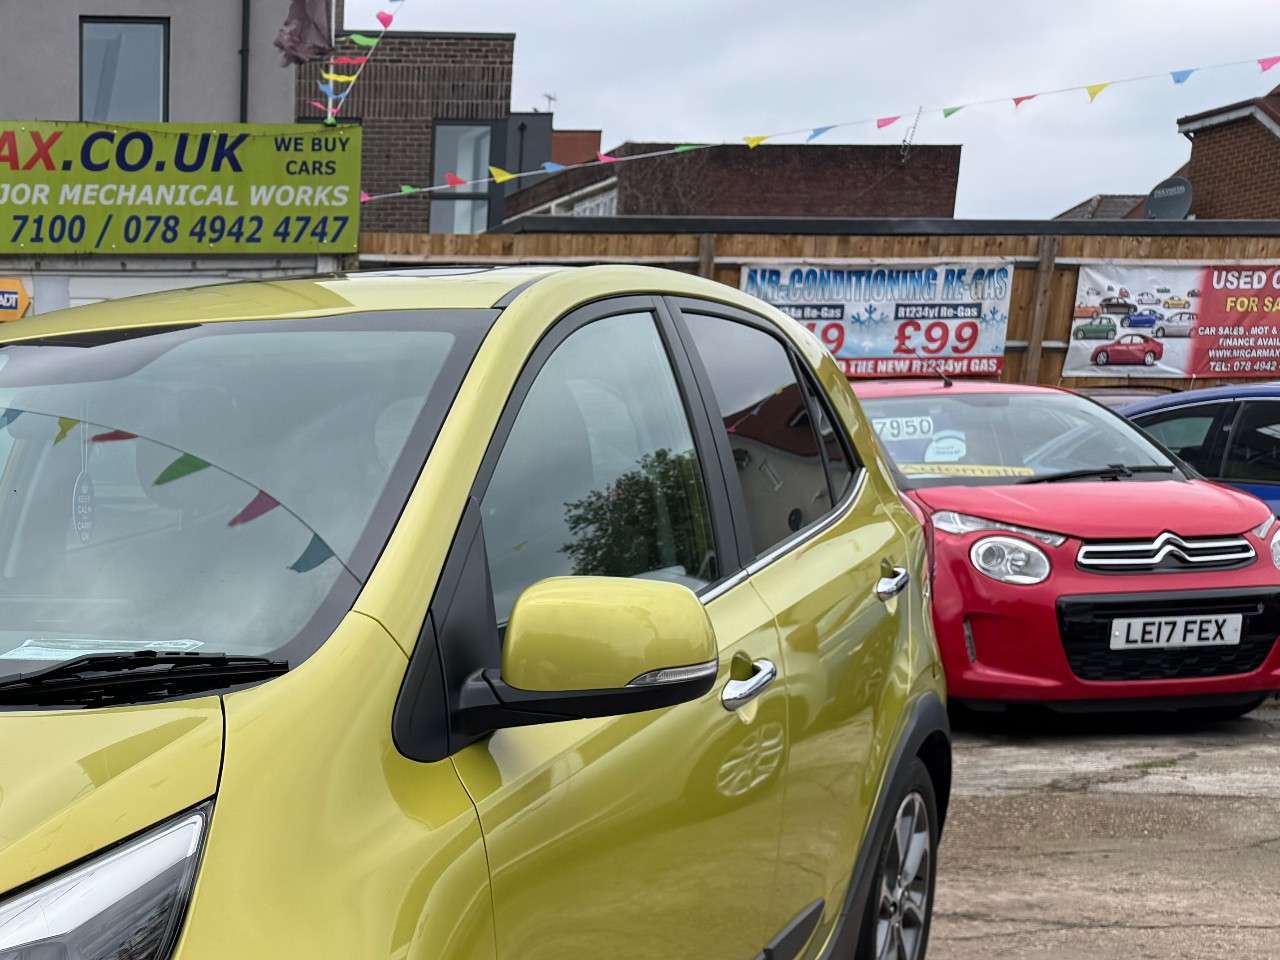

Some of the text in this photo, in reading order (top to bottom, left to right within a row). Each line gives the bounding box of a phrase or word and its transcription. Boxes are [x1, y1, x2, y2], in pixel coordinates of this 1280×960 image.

[274, 136, 350, 153] WE BUY
[285, 160, 337, 176] CARS
[58, 184, 239, 207] MECHANICAL
[249, 185, 349, 208] WORKS
[11, 215, 86, 243] 7100
[123, 215, 180, 244] 078
[190, 215, 263, 244] 4942
[273, 215, 350, 244] 4747
[941, 267, 1009, 300] RE-GAS
[1212, 270, 1267, 290] USED
[803, 306, 842, 319] Re-Gas
[940, 305, 978, 317] Re-Gas
[1225, 296, 1259, 313] FOR
[892, 319, 980, 355] £99
[1199, 326, 1216, 336] CAR
[1250, 325, 1269, 336] MOT
[849, 359, 874, 374] THE
[876, 359, 910, 374] NEW
[1233, 361, 1252, 372] 078
[1253, 361, 1277, 372] 4942
[874, 418, 932, 439] 7950
[1125, 618, 1225, 645] LE17 FEX
